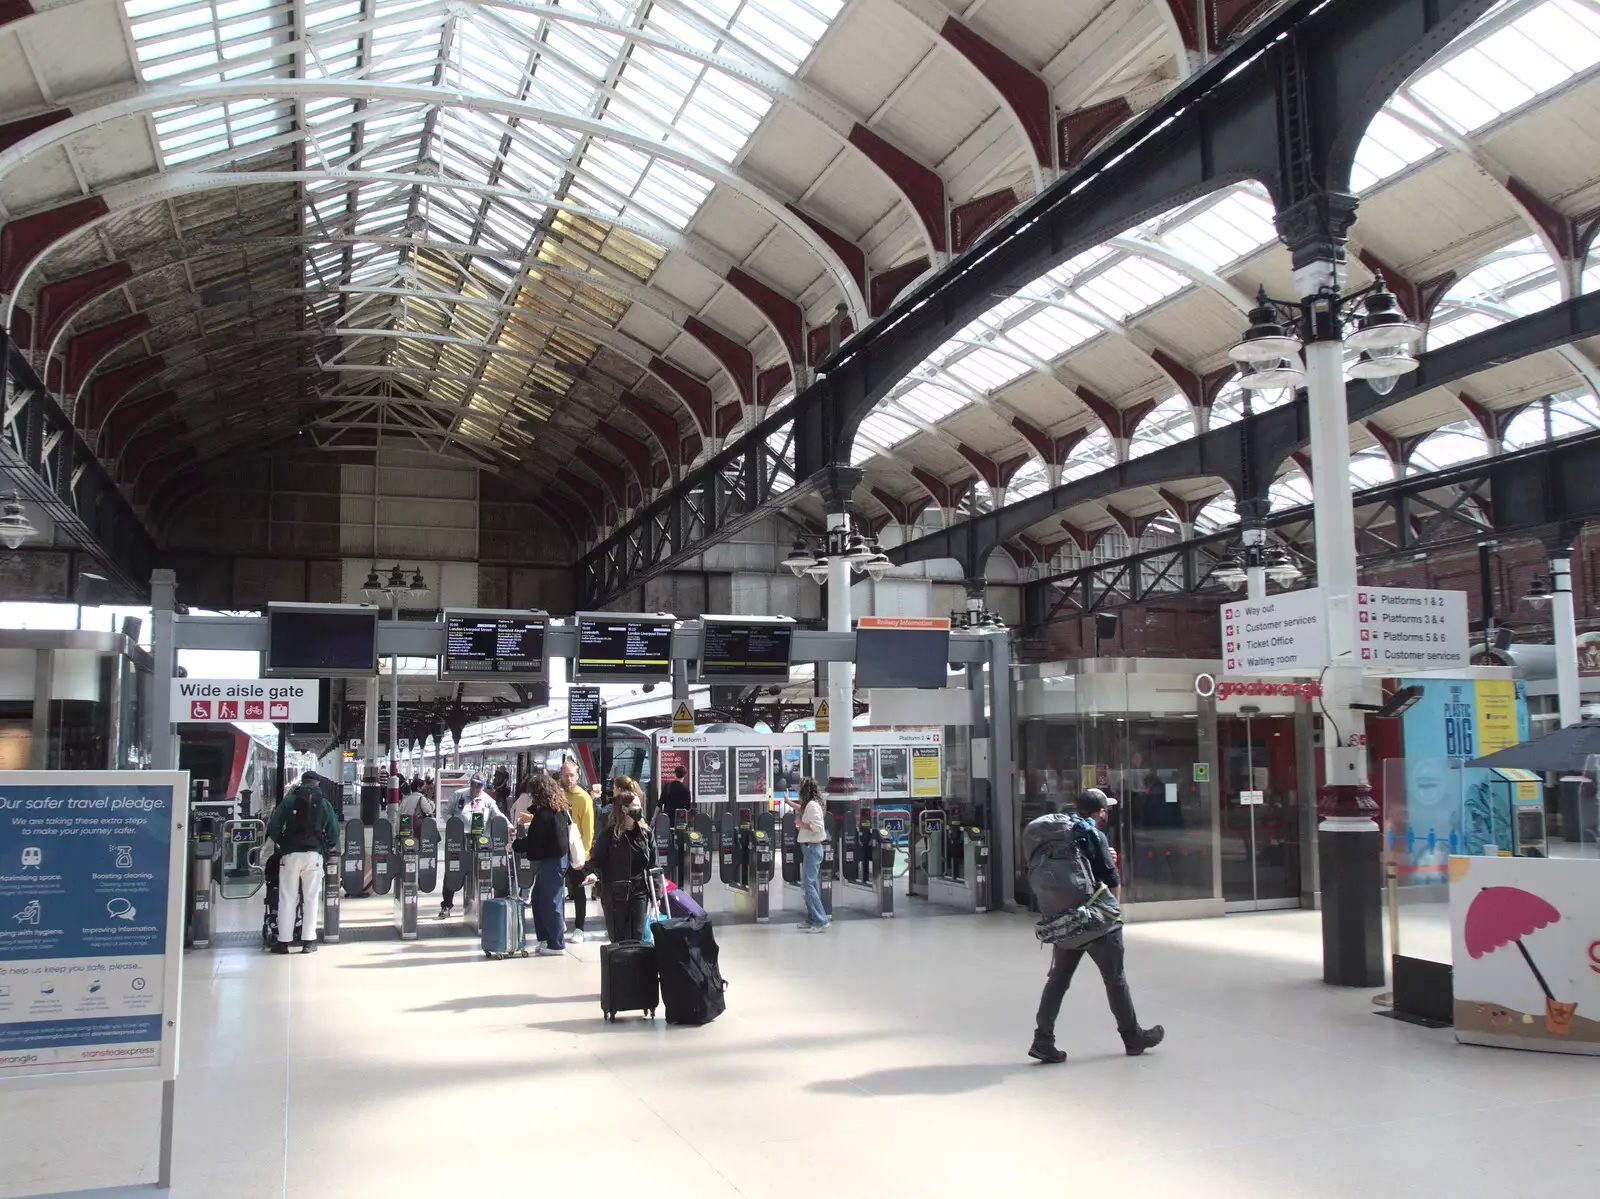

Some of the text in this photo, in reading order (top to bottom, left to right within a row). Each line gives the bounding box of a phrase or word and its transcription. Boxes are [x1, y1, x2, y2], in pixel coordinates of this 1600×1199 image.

[1382, 595, 1444, 606] Platforms 1 & 2
[1245, 604, 1275, 616] Way out
[876, 618, 900, 628] Railway
[1246, 615, 1316, 633] Customer services
[1382, 614, 1445, 624] Platforms 3 & 4
[1384, 632, 1446, 642] Platforms 5 & 6
[1246, 636, 1294, 650] Ticket Office
[1247, 654, 1298, 668] Waiting room
[1384, 650, 1460, 661] Customer services
[180, 684, 304, 700] Wide aisle gate
[0, 796, 166, 812] Our safer travel pledge.
[45, 818, 73, 827] taking
[75, 817, 99, 825] these
[125, 816, 148, 826] steps
[59, 828, 79, 837] your
[80, 827, 112, 837] journey
[114, 826, 136, 835] safer.
[92, 872, 154, 881] Boosting cleaning.
[82, 927, 116, 936] Improving
[9, 967, 29, 976] help
[31, 967, 42, 975] us
[45, 964, 67, 974] keep
[68, 965, 85, 974] you
[86, 964, 106, 972] safe,
[81, 1047, 155, 1059] stanstedexpress
